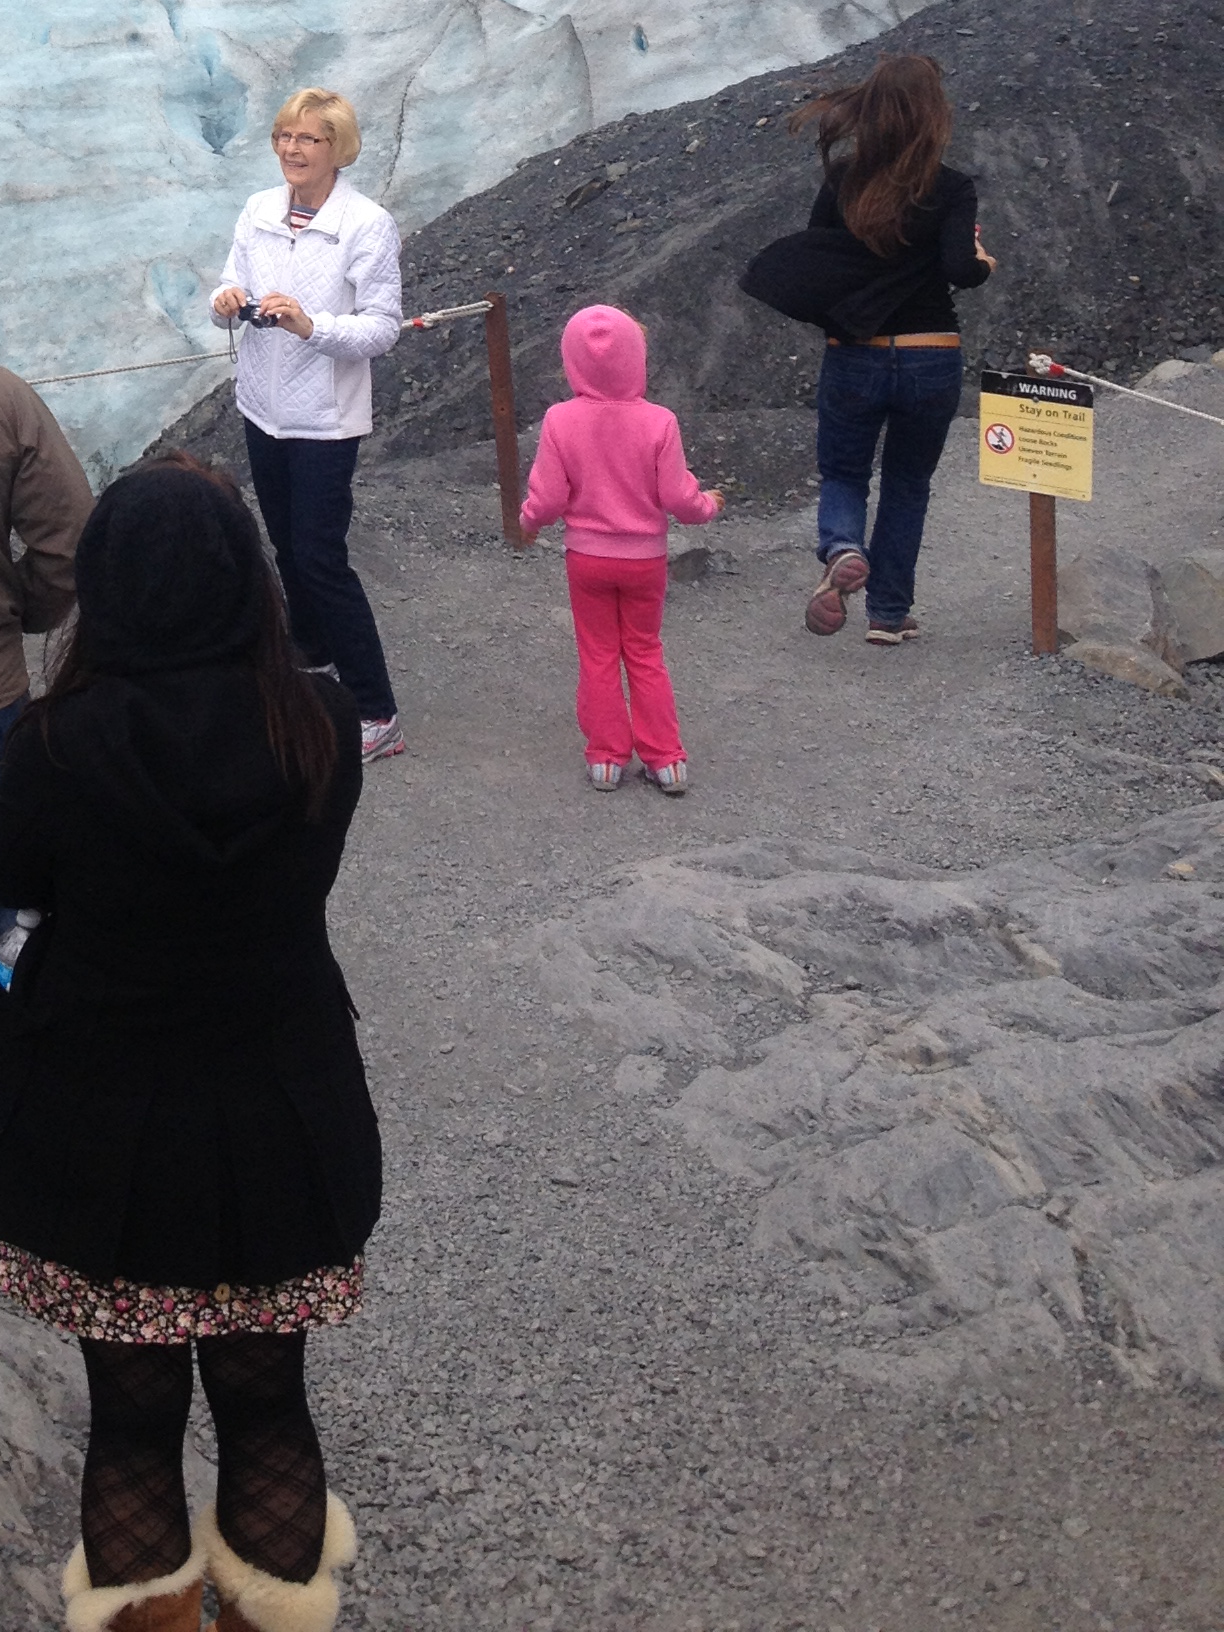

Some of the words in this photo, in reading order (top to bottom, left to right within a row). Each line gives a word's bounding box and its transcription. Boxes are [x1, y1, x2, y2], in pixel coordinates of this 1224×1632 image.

[1018, 382, 1077, 400] WARNING
[1019, 403, 1042, 417] Stay
[1045, 409, 1059, 417] on
[1062, 410, 1085, 422] Trail
[1018, 426, 1052, 436] Hazardous
[1053, 431, 1087, 441] Conditions
[1018, 436, 1037, 444] Loose
